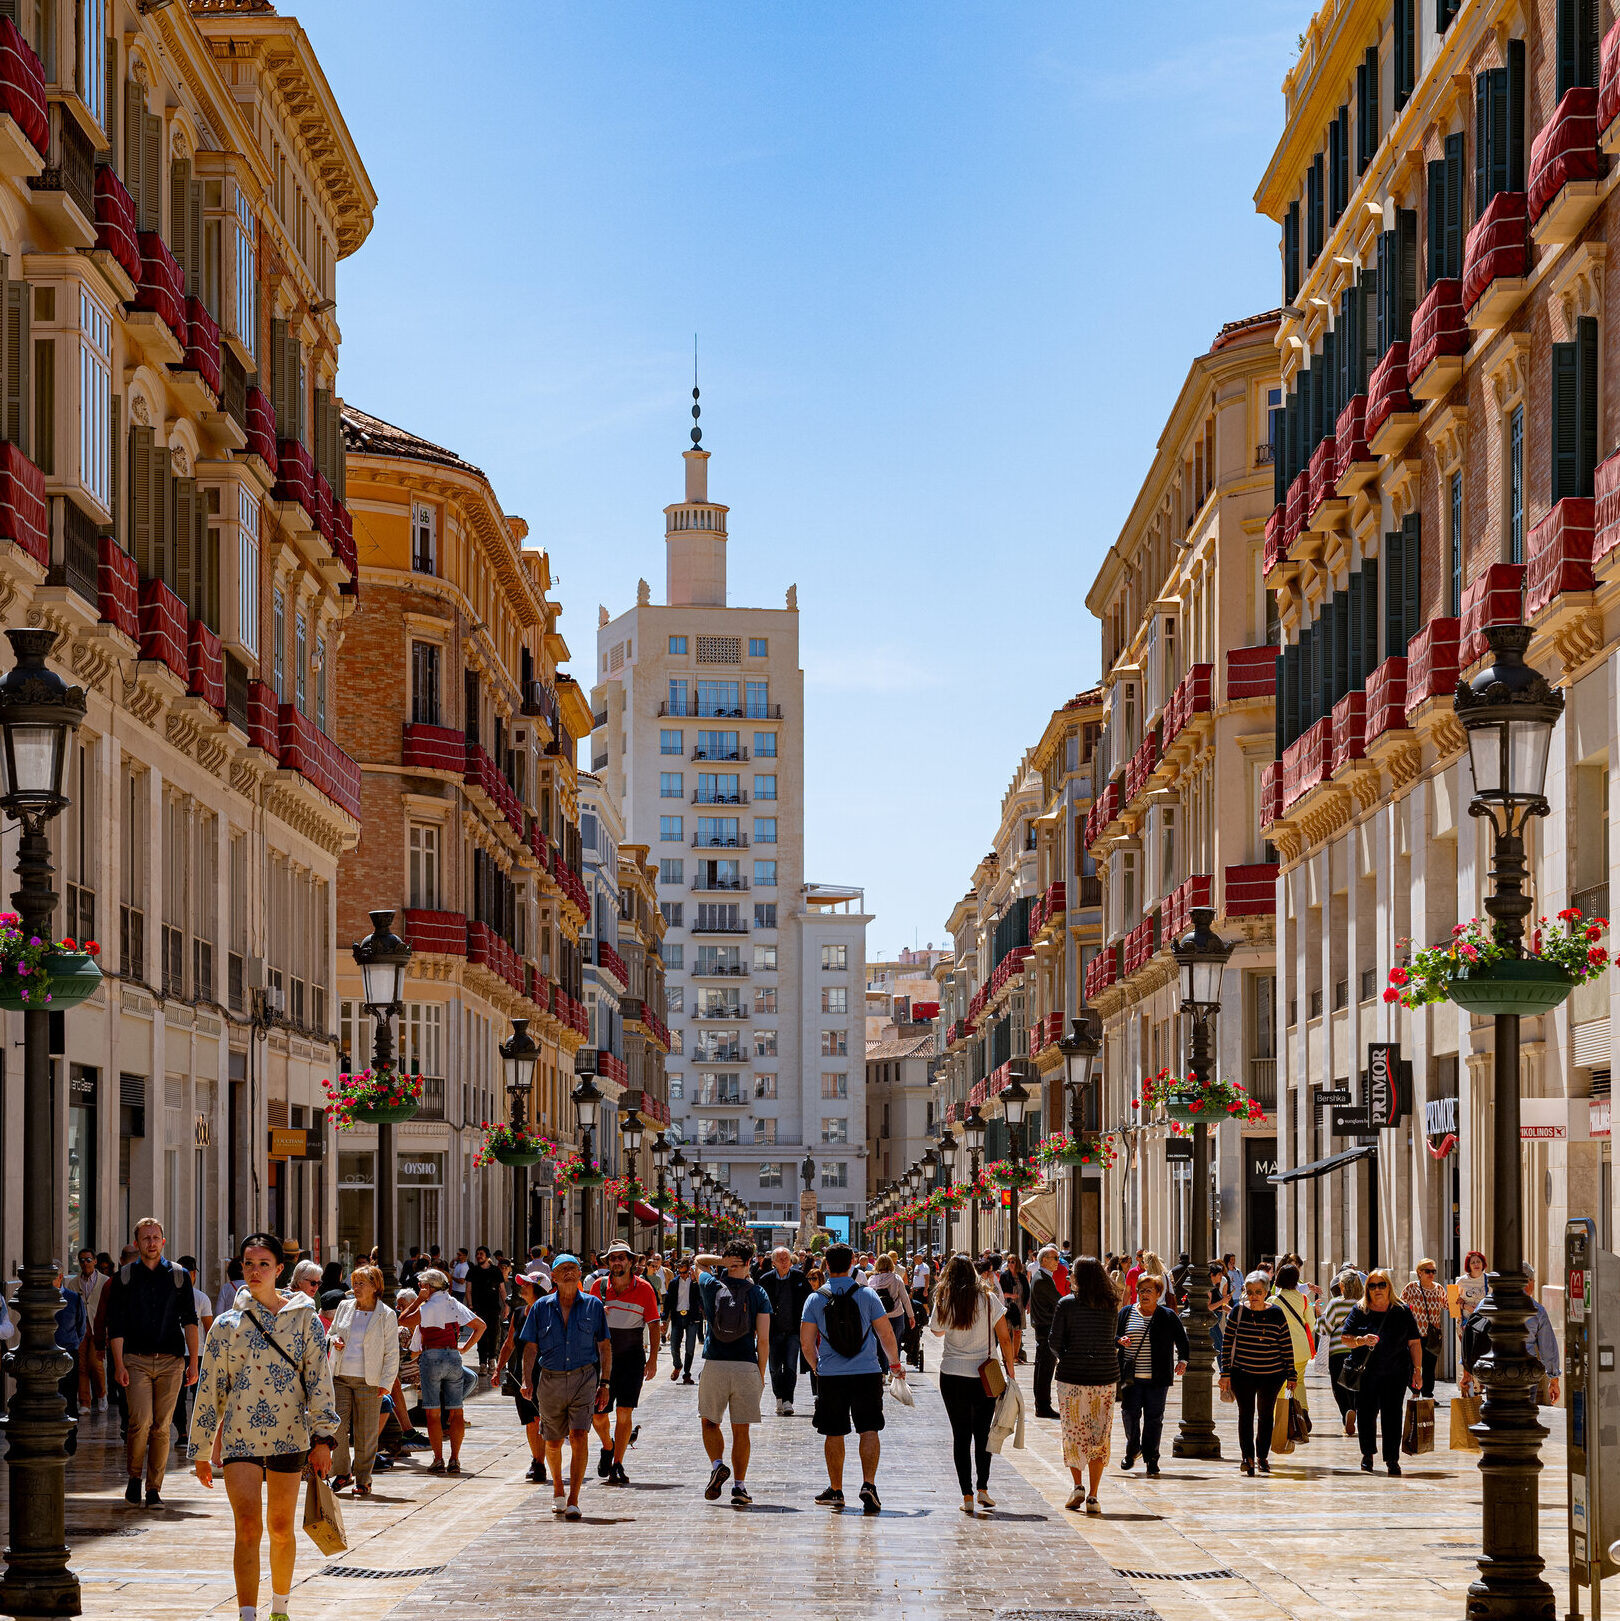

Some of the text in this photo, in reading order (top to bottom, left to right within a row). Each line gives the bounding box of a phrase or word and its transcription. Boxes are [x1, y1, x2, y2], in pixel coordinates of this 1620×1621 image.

[1372, 1047, 1387, 1125] PRIMOR
[1316, 1094, 1346, 1103] Bershka
[1425, 1098, 1457, 1134] PRIMOR
[1520, 1127, 1553, 1137] IKOLINOS
[404, 1162, 436, 1175] OYSHO
